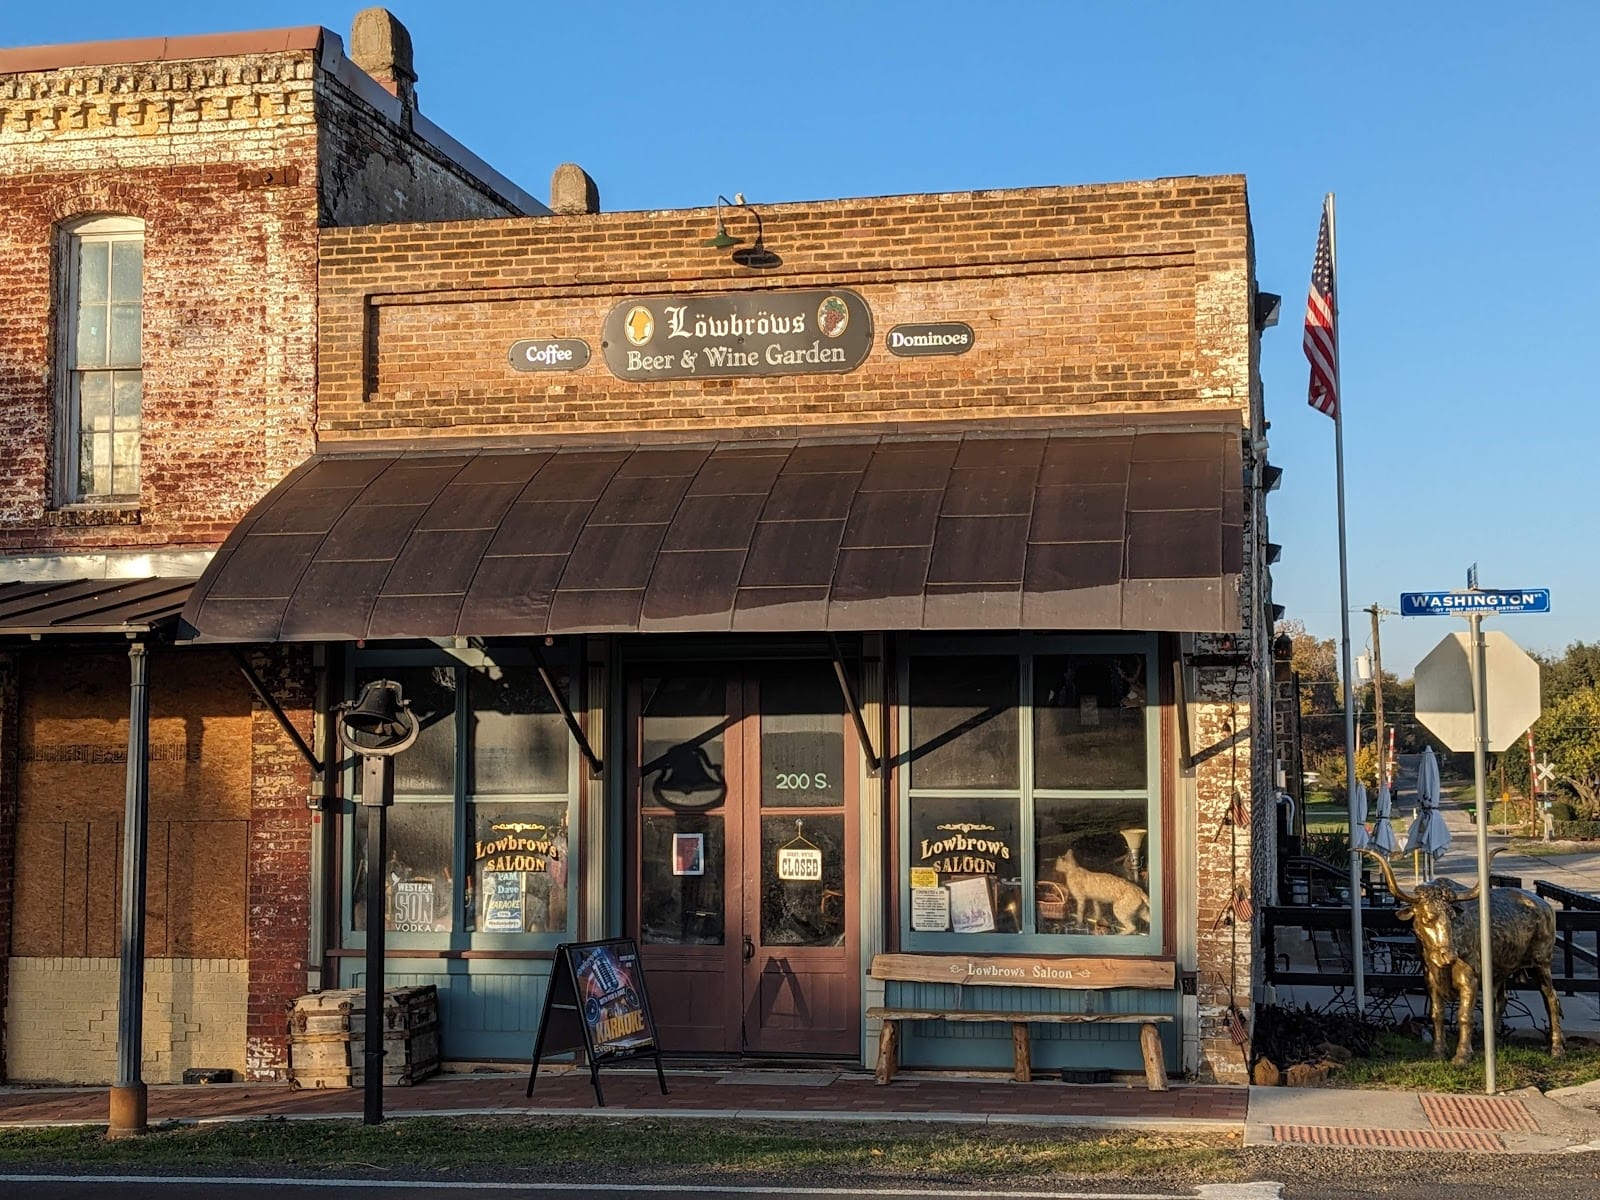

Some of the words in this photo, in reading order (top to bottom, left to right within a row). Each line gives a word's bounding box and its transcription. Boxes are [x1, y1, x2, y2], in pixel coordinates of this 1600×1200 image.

[664, 305, 806, 339] Löwbröws
[891, 329, 968, 347] Dominoes
[525, 345, 573, 363] Coffee
[626, 350, 675, 371] Beer
[680, 349, 698, 373] &
[703, 346, 760, 368] Wine
[765, 340, 846, 366] Garden
[1411, 594, 1534, 608] WASHINGTON
[775, 773, 810, 789] 200
[814, 772, 832, 789] S.
[474, 835, 560, 861] Lowbrow's
[920, 834, 1010, 860] Lowbrow's
[487, 857, 547, 872] SALOON
[782, 858, 819, 876] CLOSED
[933, 856, 997, 874] SALOON
[397, 883, 433, 892] WESTERN
[498, 885, 519, 894] Dave
[395, 892, 434, 923] SON
[395, 924, 432, 932] VODKA
[967, 963, 1025, 977] Lowbrow's
[1032, 965, 1073, 979] Saloon
[595, 1009, 645, 1043] KARAOKE
[593, 1044, 616, 1054] Every
